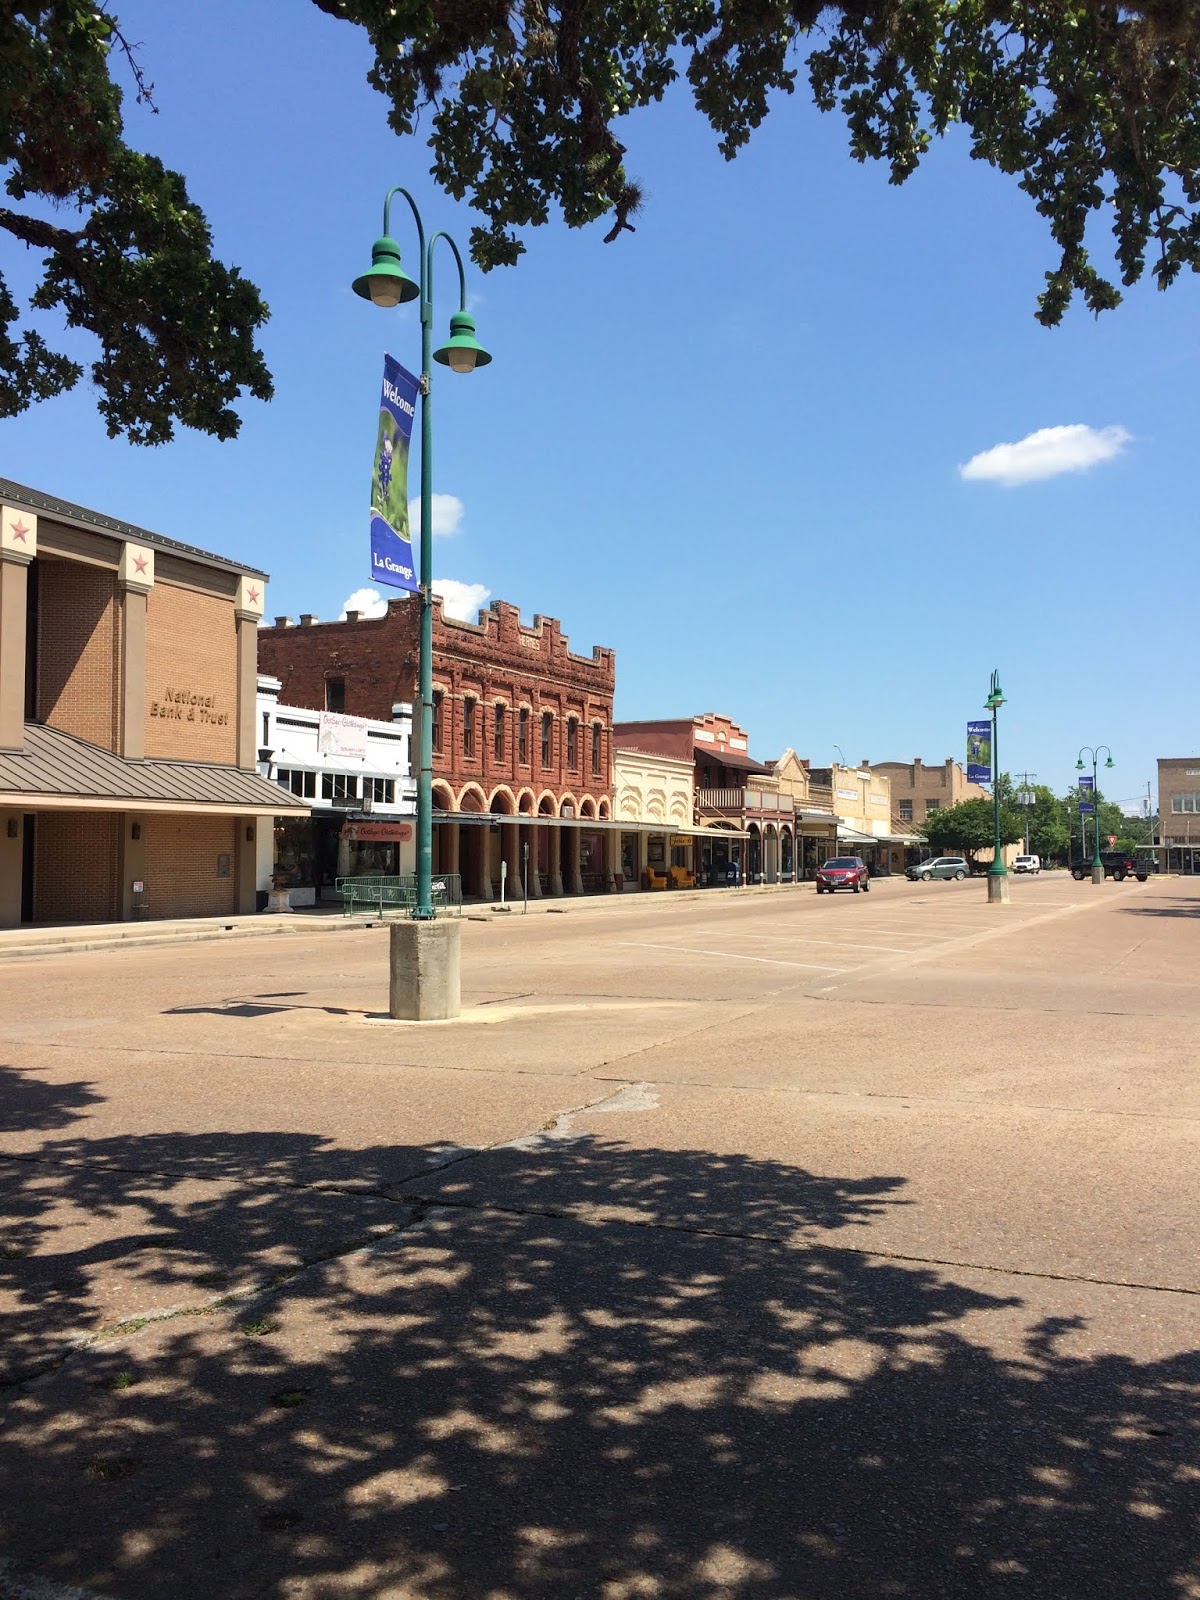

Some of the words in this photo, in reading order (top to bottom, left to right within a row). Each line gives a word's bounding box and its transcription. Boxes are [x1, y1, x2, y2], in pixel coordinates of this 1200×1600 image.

[382, 378, 415, 418] Welcome
[373, 552, 385, 568] La
[385, 557, 413, 580] Grange
[165, 687, 215, 708] National
[150, 700, 182, 720] Bank
[187, 707, 195, 722] &
[200, 708, 228, 726] Trust
